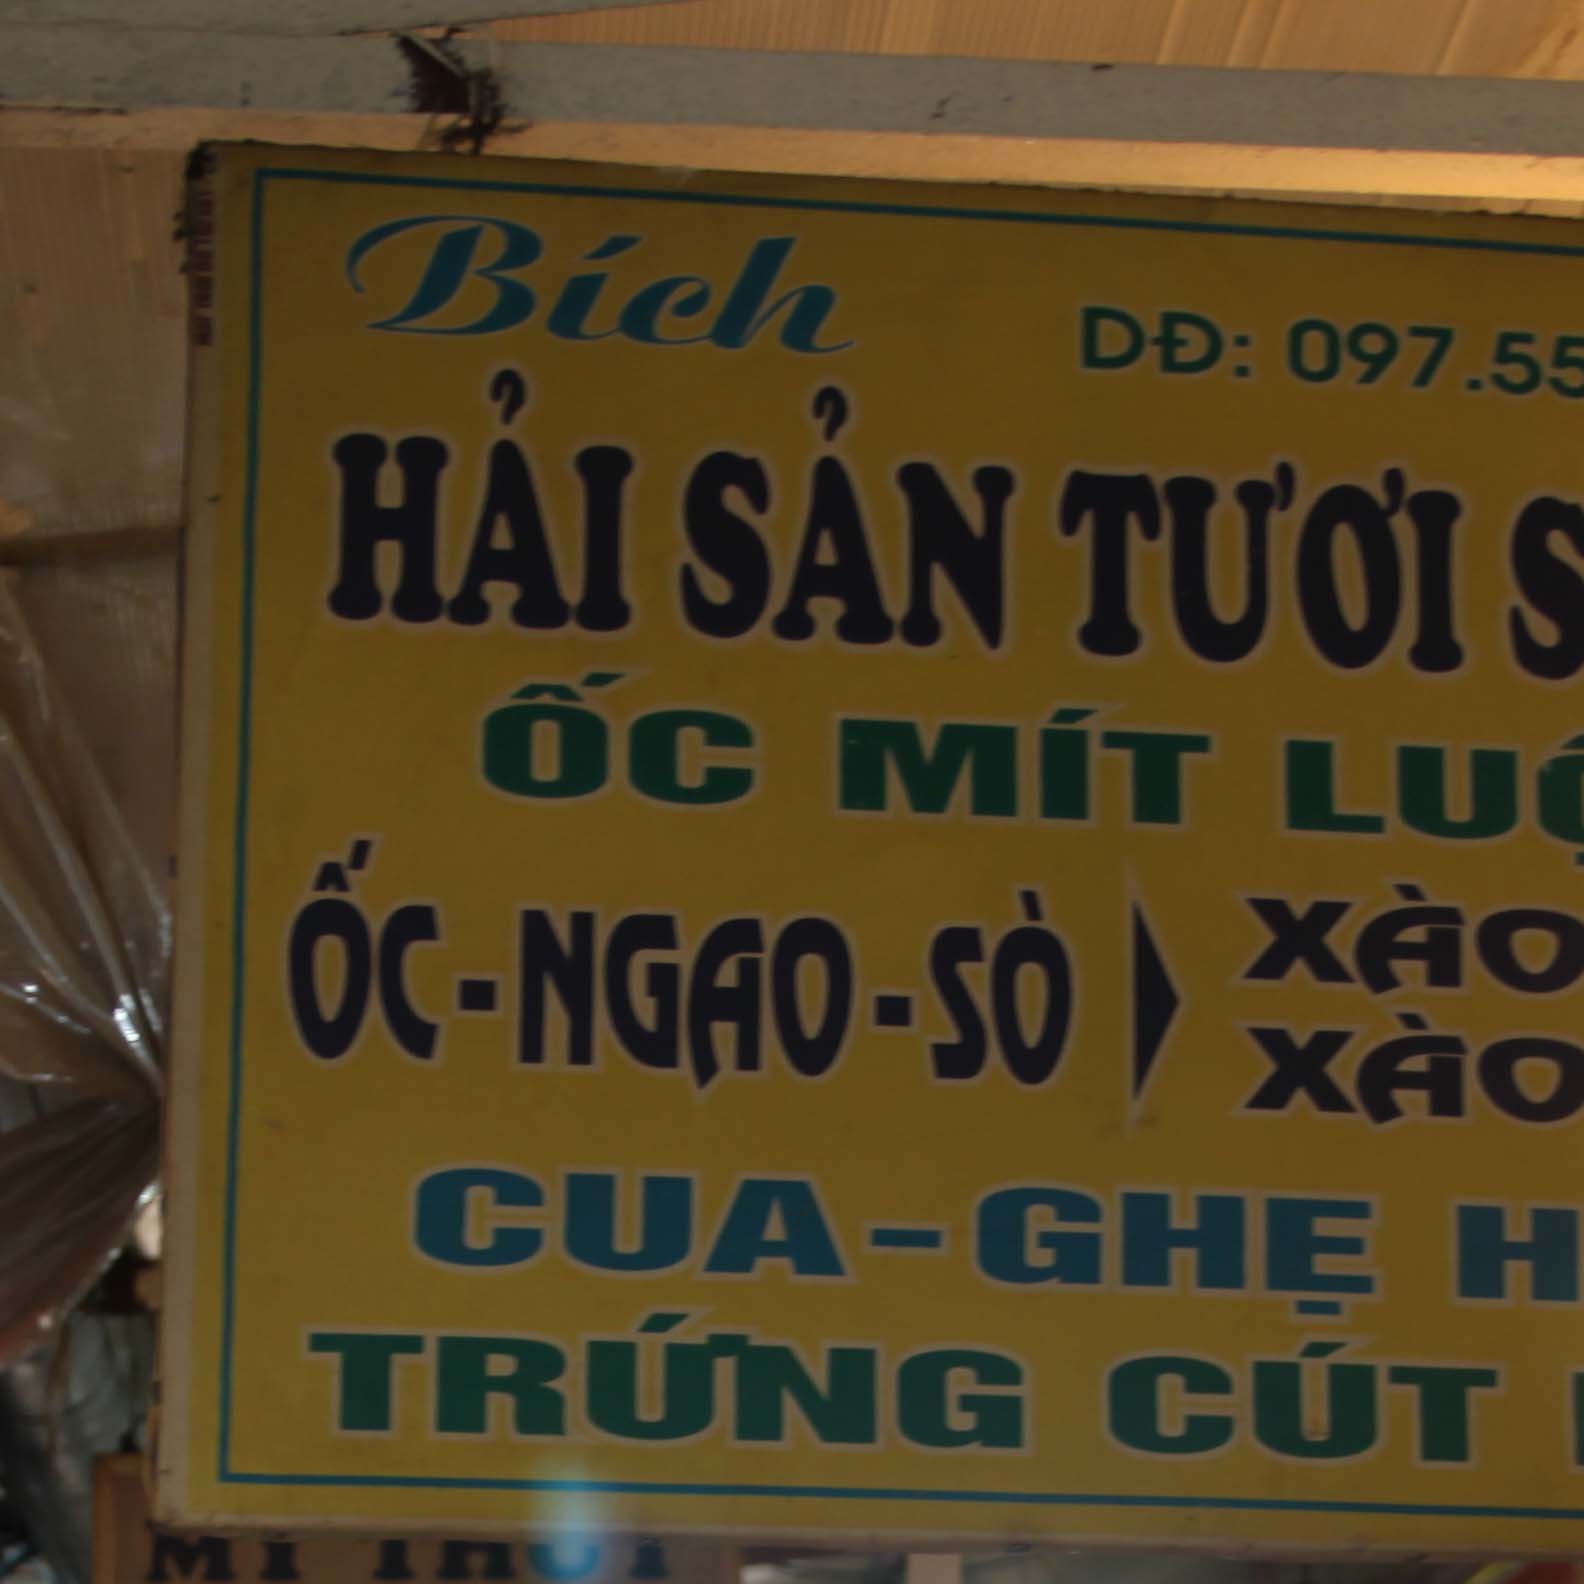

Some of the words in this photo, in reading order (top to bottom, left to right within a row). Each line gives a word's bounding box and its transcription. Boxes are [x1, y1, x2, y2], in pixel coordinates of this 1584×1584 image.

[345, 214, 854, 356] Bích
[1079, 304, 1252, 376] DĐ:
[326, 367, 636, 633] HẢI
[678, 384, 1017, 651] SẢN
[1058, 460, 1466, 674] TƯƠI
[481, 670, 756, 806] ỐC
[837, 706, 1213, 826] MÍT
[307, 1311, 1025, 1450] TRỨNG
[1107, 1340, 1499, 1464] CÚT
